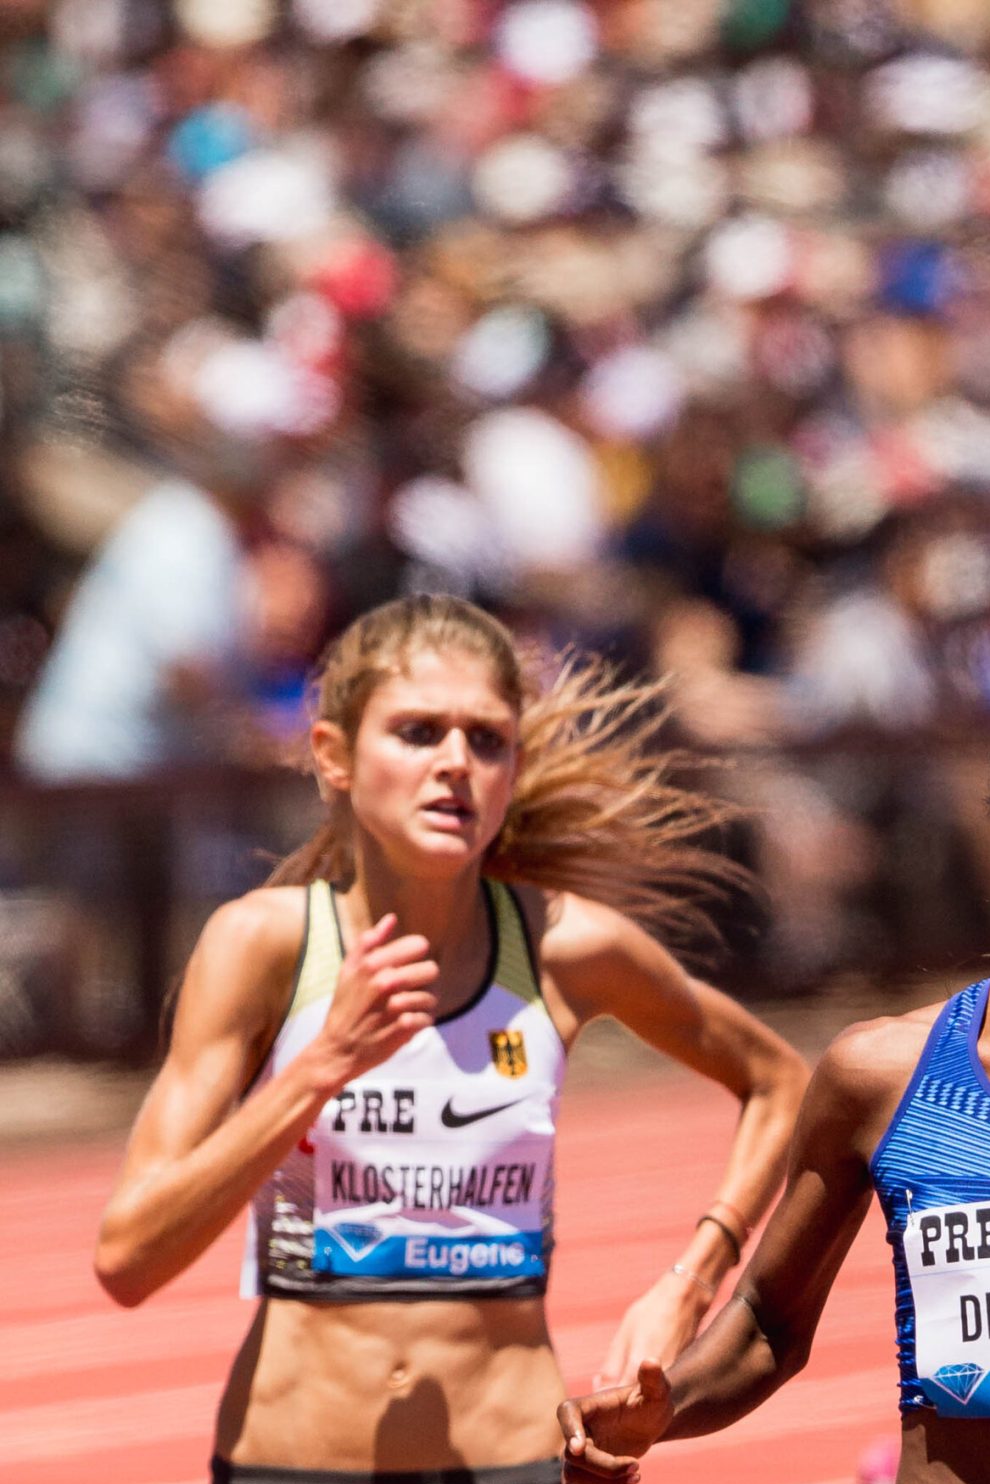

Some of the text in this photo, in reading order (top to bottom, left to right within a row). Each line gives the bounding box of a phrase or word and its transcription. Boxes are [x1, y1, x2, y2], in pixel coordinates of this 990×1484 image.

[332, 1089, 415, 1134] PRE
[331, 1160, 536, 1211] KLOSTERHALFEN
[404, 1238, 526, 1275] Eugene
